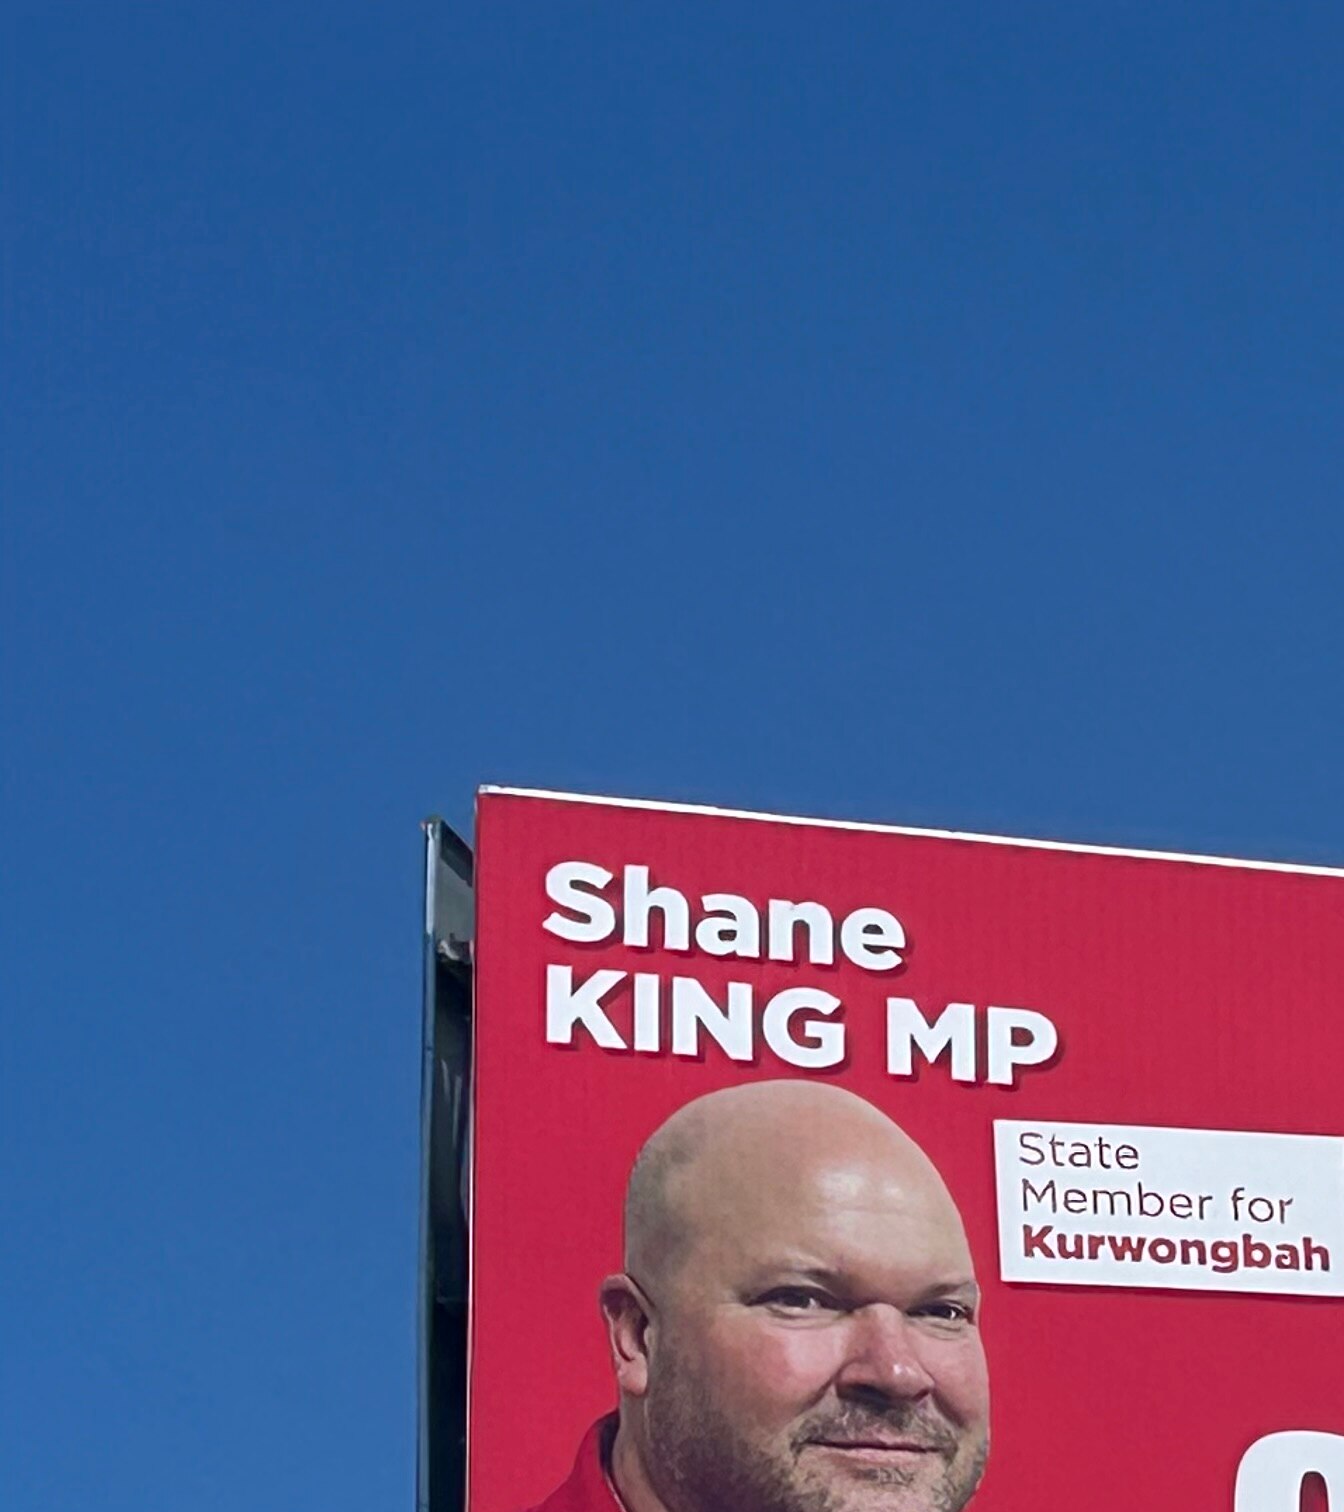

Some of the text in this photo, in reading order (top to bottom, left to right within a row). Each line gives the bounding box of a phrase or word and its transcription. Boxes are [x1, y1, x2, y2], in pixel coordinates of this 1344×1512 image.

[542, 861, 906, 971] Shane
[546, 964, 1058, 1085] KING MP
[1019, 1131, 1140, 1170] State
[1021, 1178, 1294, 1225] Member for
[1022, 1223, 1330, 1274] Kurwongbah
